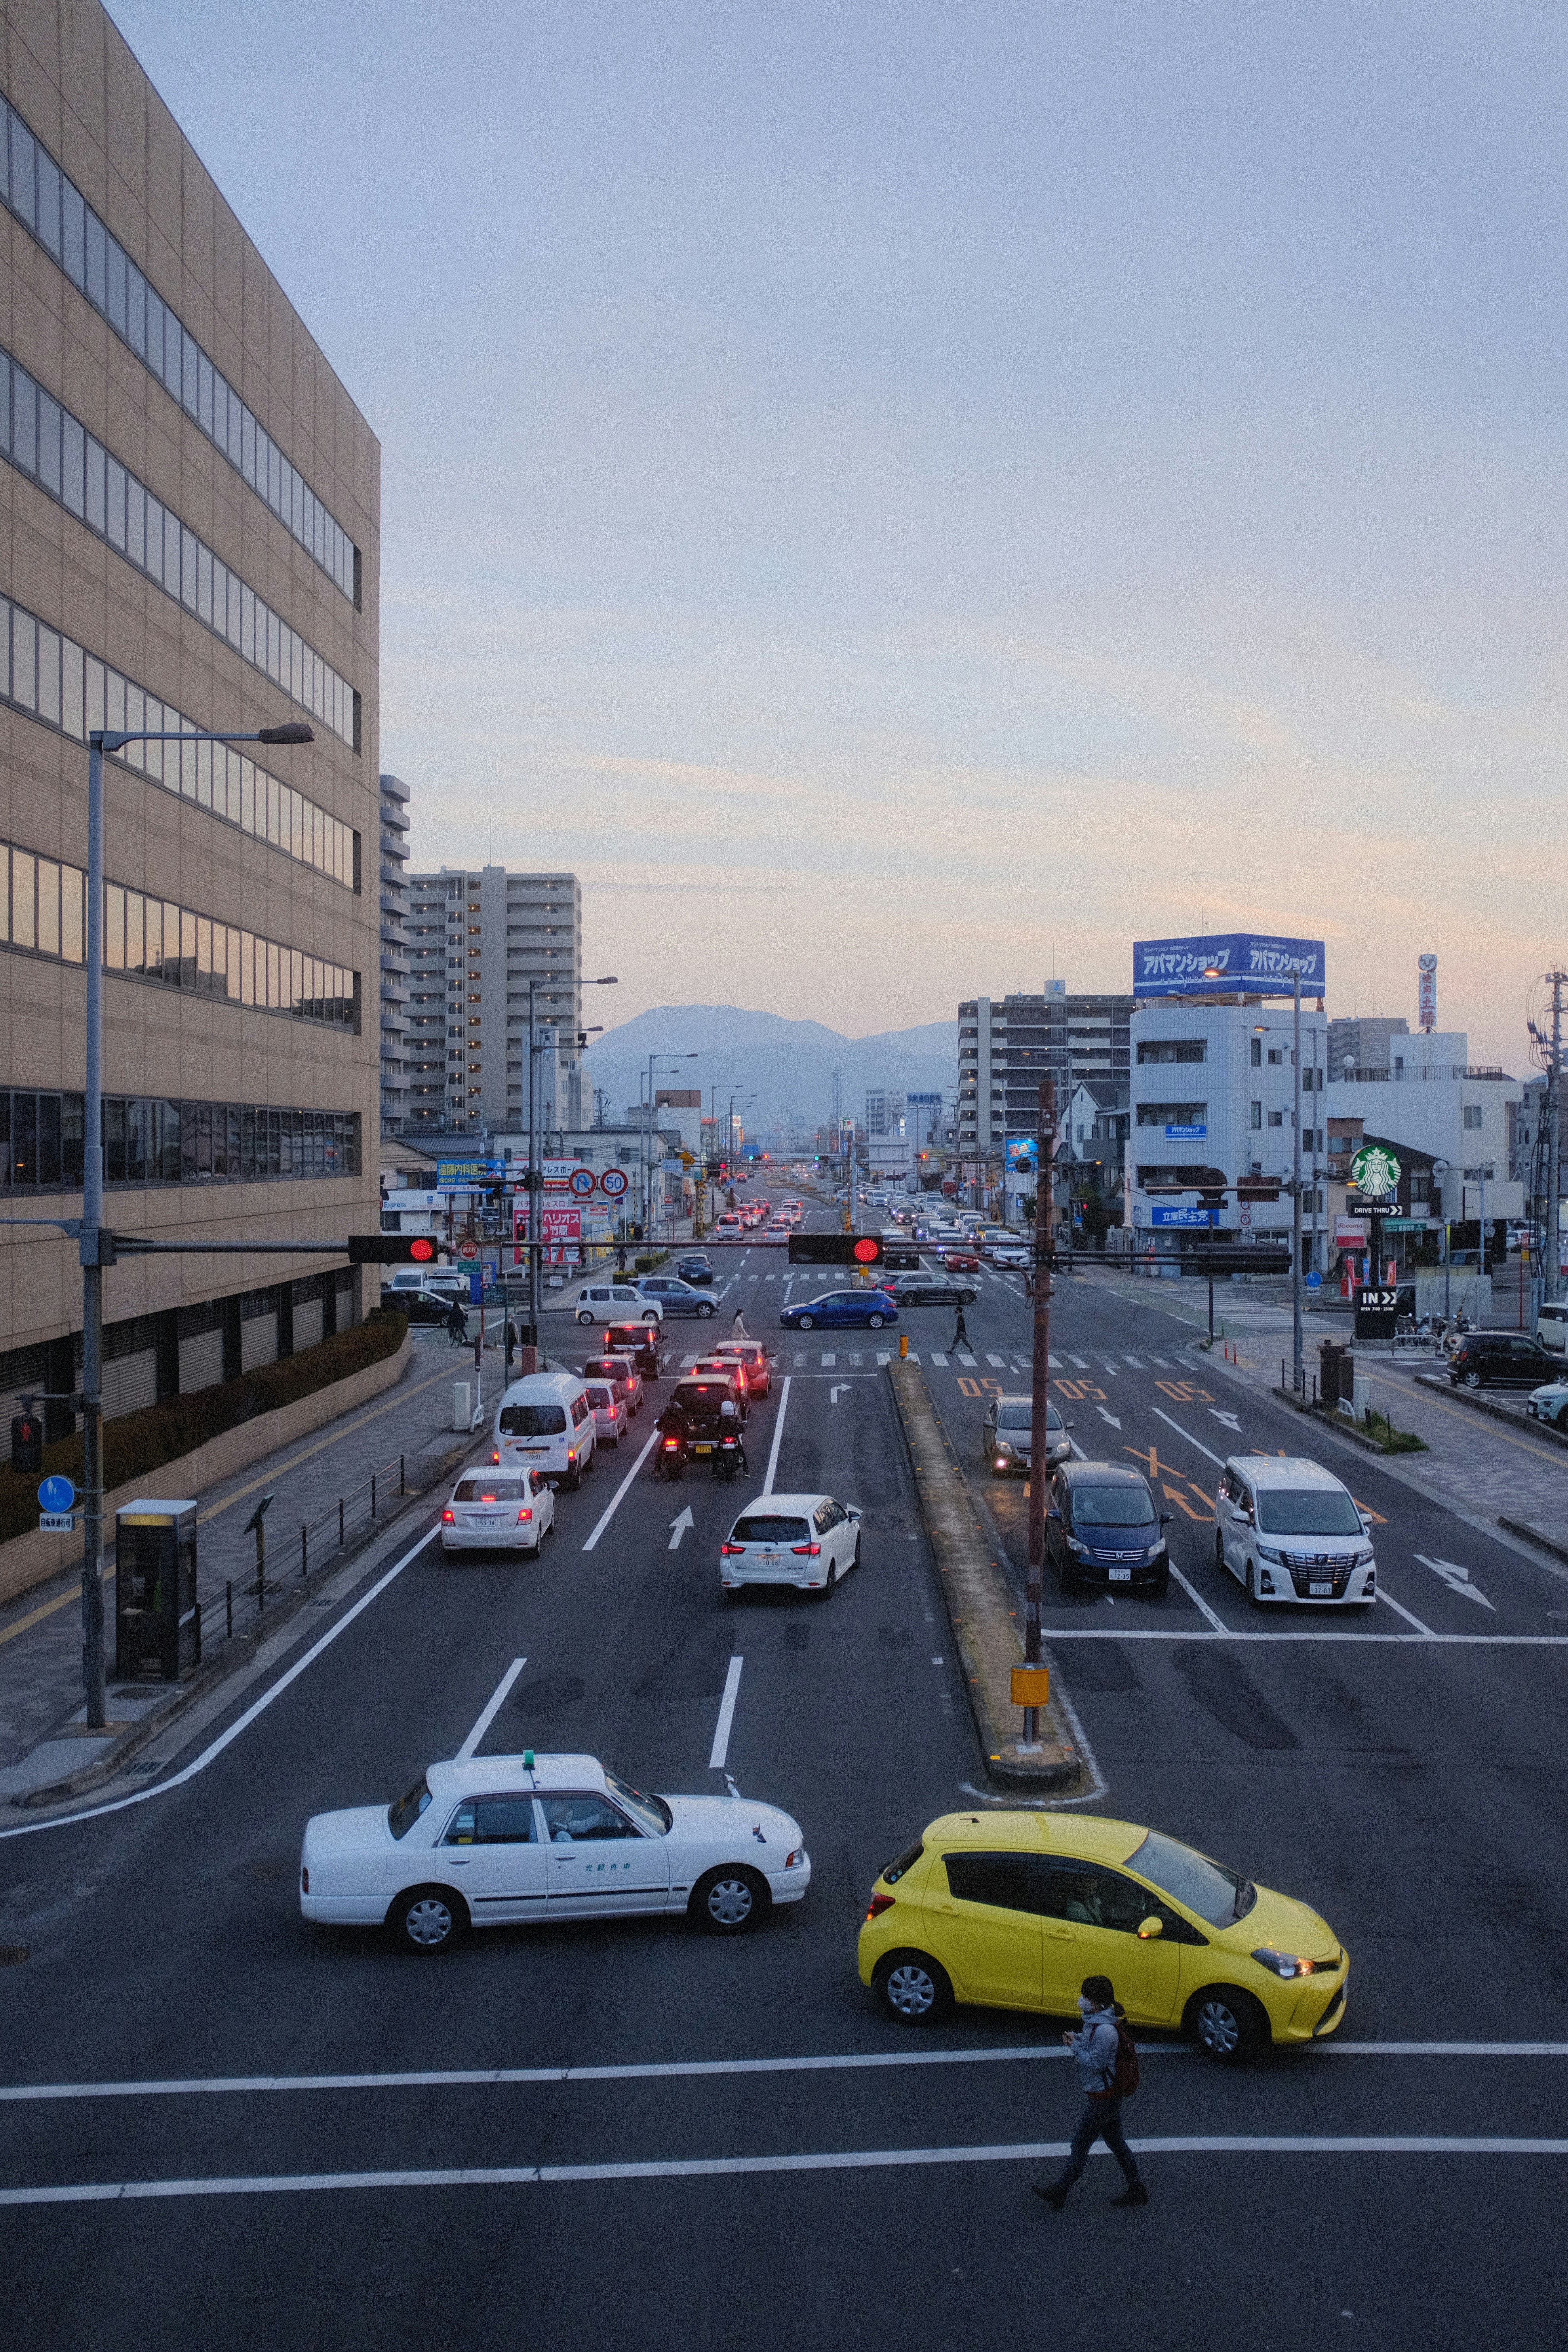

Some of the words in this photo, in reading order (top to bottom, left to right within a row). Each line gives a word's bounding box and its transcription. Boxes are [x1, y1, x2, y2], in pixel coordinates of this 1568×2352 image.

[1144, 948, 1230, 975] アパマンショップ
[1250, 949, 1317, 974] アパマンショップ
[1264, 975, 1305, 984] NETWOK
[438, 1163, 487, 1176] 遠藤内科医院
[606, 1176, 622, 1189] 50
[516, 1213, 579, 1224] 丸ヘリオス
[1162, 1208, 1208, 1223] 立憲民主党
[550, 1225, 568, 1236] 竹原
[1362, 1292, 1378, 1304] IN
[956, 1377, 1004, 1397] 50
[1053, 1379, 1108, 1400] 50
[1154, 1381, 1216, 1402] 50
[41, 1518, 70, 1528] 自転車通行可
